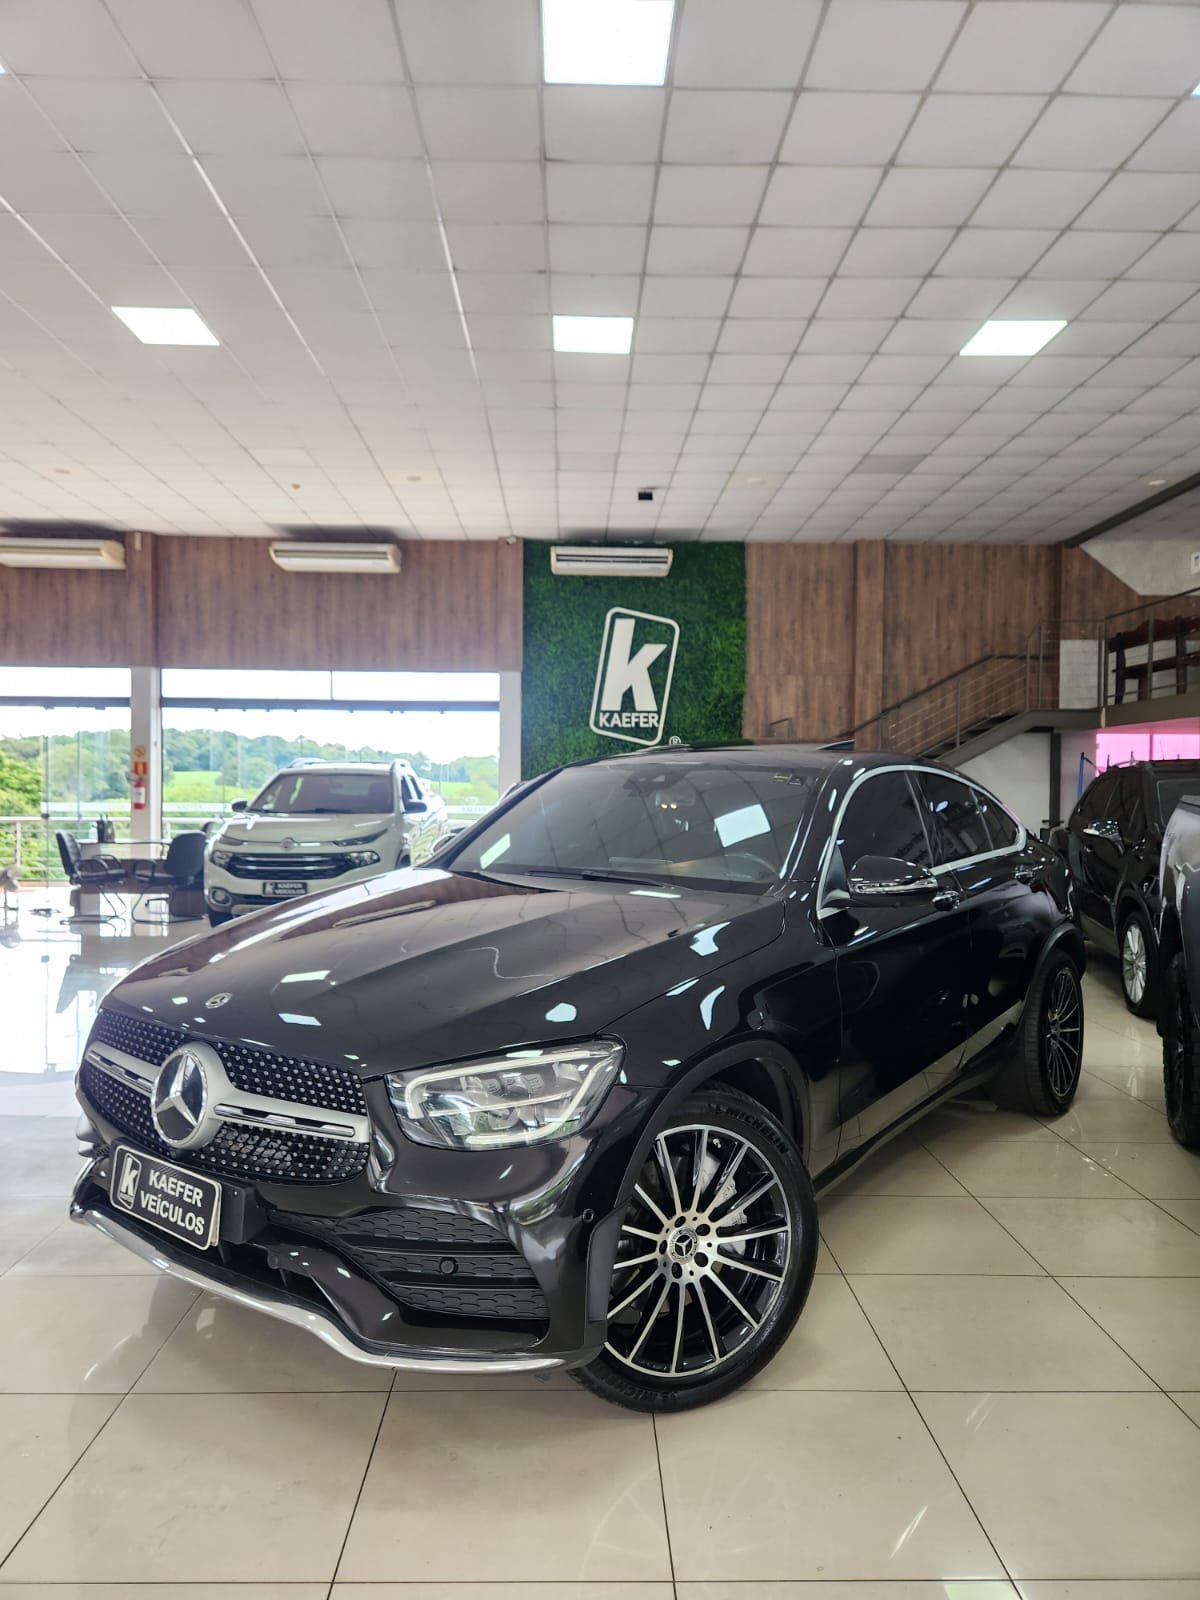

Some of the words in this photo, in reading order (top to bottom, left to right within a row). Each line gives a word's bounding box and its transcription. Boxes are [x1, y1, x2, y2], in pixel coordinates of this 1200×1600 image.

[600, 713, 659, 728] KAEFER
[148, 1169, 204, 1208] KAEFER
[140, 1190, 205, 1236] VEÍCULOS
